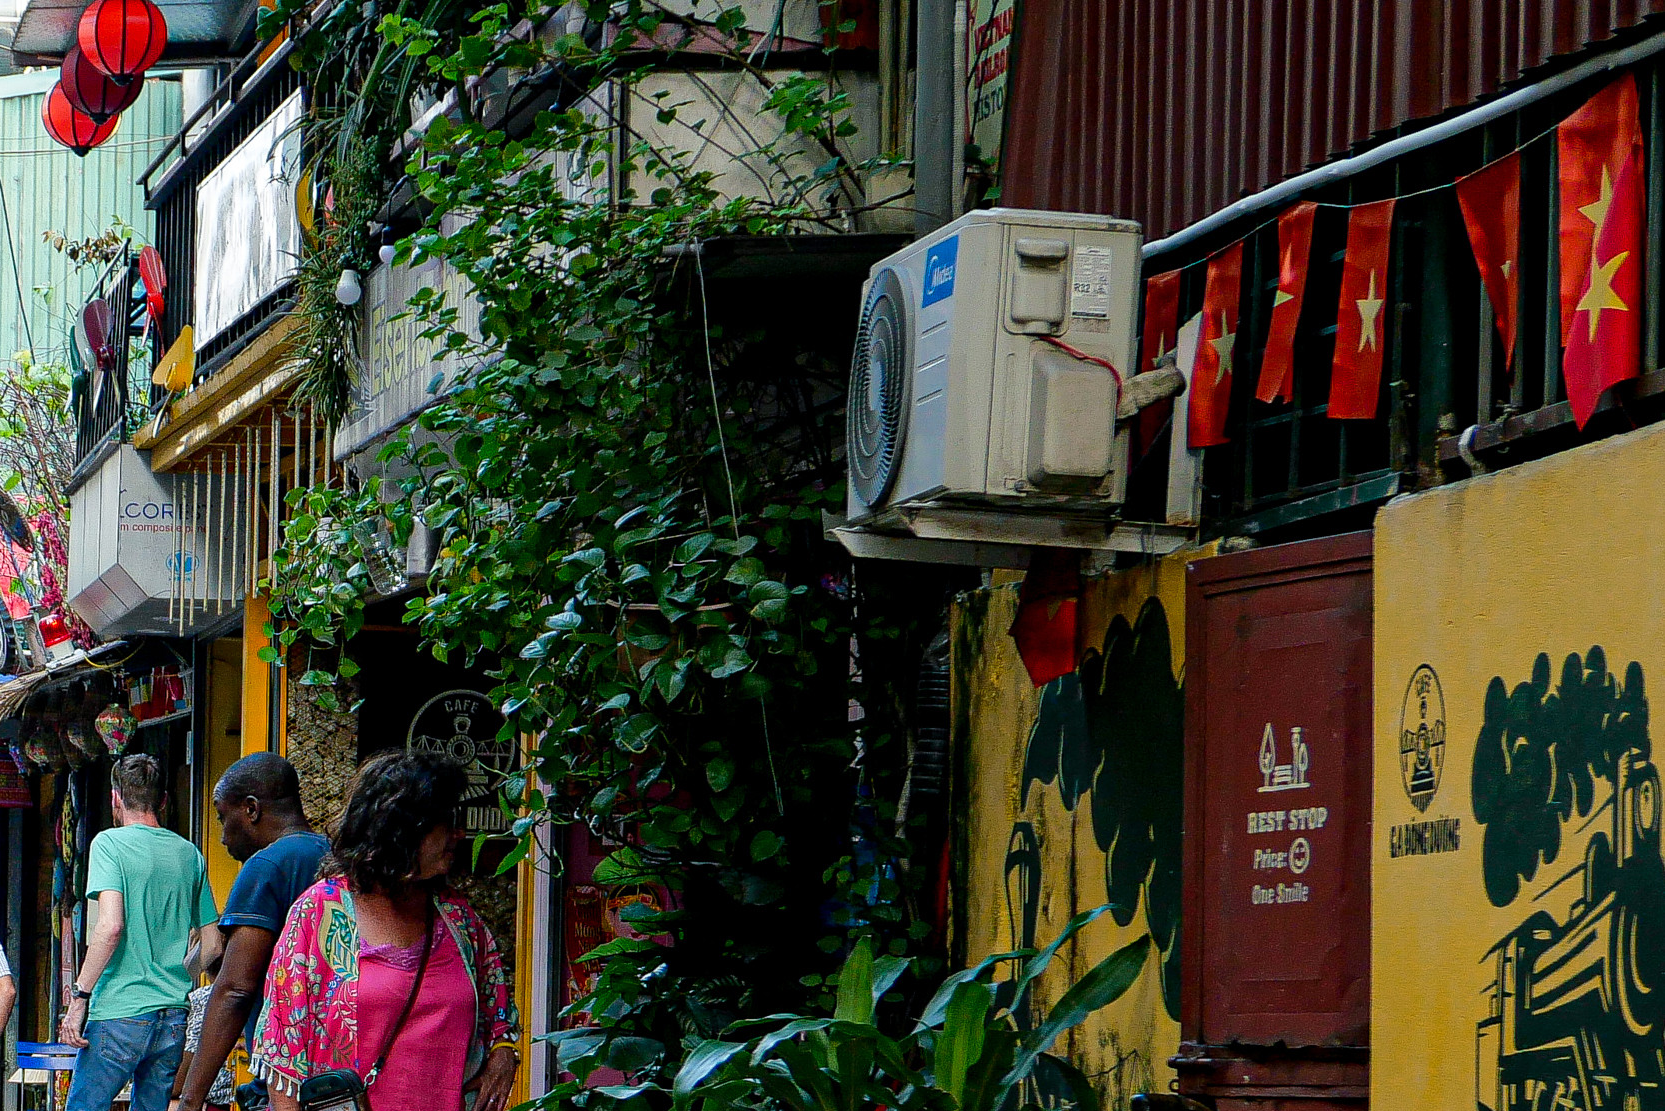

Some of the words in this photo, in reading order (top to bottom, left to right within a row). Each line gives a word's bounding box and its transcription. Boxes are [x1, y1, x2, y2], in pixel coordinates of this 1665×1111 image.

[1247, 811, 1286, 834] REST
[1288, 807, 1328, 830] STOP
[1251, 885, 1275, 905] One
[1276, 882, 1309, 904] Smile
